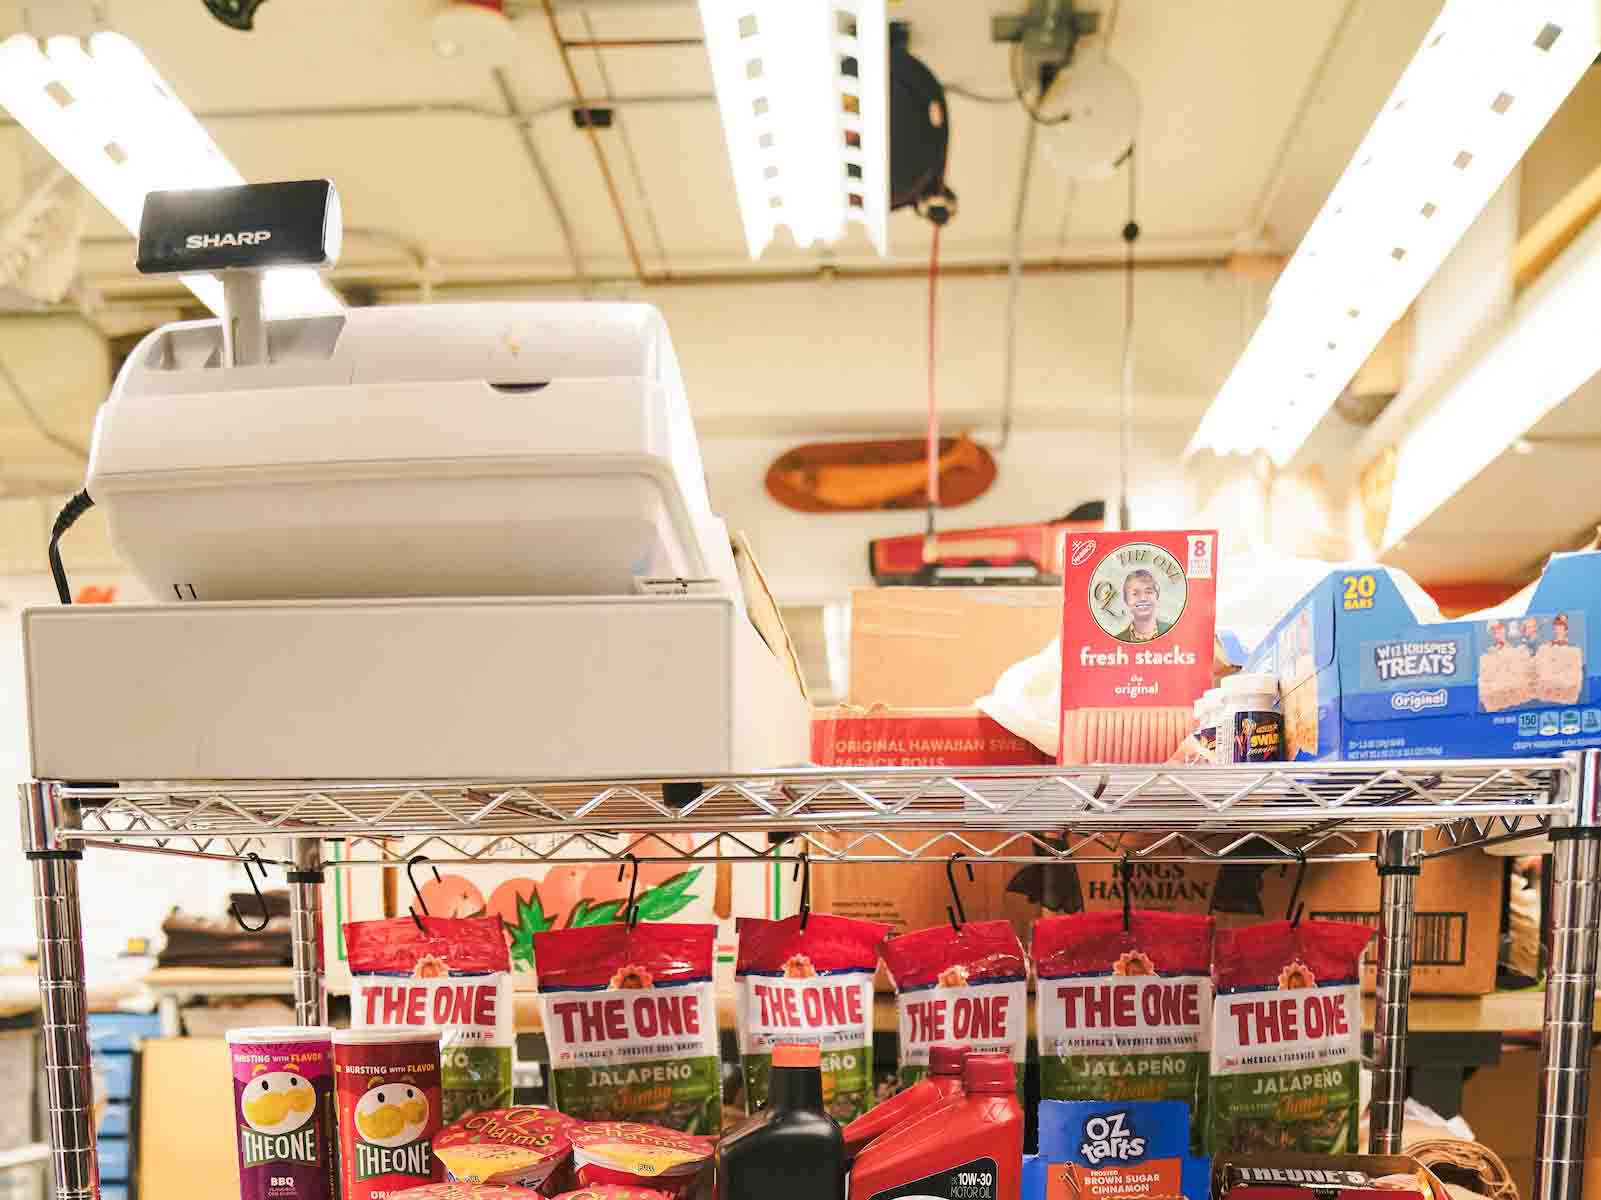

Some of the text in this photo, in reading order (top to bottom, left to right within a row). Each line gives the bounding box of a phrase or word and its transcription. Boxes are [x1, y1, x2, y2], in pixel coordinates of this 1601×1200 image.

[186, 230, 271, 249] SHARP
[1194, 539, 1206, 557] 8
[1343, 576, 1376, 597] 20
[1343, 597, 1374, 610] BARS
[1080, 644, 1196, 665] fresh stacks
[1401, 641, 1457, 657] KRISPIES
[1377, 653, 1456, 680] TREATS
[1130, 674, 1143, 682] the
[1115, 682, 1159, 698] original
[1393, 690, 1446, 711] Original
[835, 738, 985, 753] ORIGINAL HAWAIIAN
[361, 985, 498, 1026] THE ONE
[754, 984, 865, 1028] THE ONE
[1057, 984, 1200, 1029] THE ONE
[553, 995, 702, 1043] THE ONE
[906, 996, 1009, 1042] THE ONE
[1230, 993, 1349, 1047] THE ONE
[345, 1065, 388, 1073] BURSTING
[408, 1063, 435, 1073] FLAVOR
[590, 1063, 693, 1087] JALAPEÑO
[1079, 1057, 1188, 1077] JALAPEÑO
[1253, 1071, 1343, 1095] JALAPEÑO
[465, 1115, 553, 1149] Charms
[1086, 1112, 1130, 1141] OZ
[242, 1129, 316, 1163] THEONE
[1081, 1136, 1145, 1164] tarts
[356, 1141, 431, 1176] THEONE
[271, 1177, 295, 1188] BBQ
[958, 1172, 992, 1186] 10W-30
[1084, 1174, 1160, 1185] BROWN SUGAR
[1091, 1183, 1150, 1194] CINNAMON
[950, 1186, 992, 1199] MOTOR OIL
